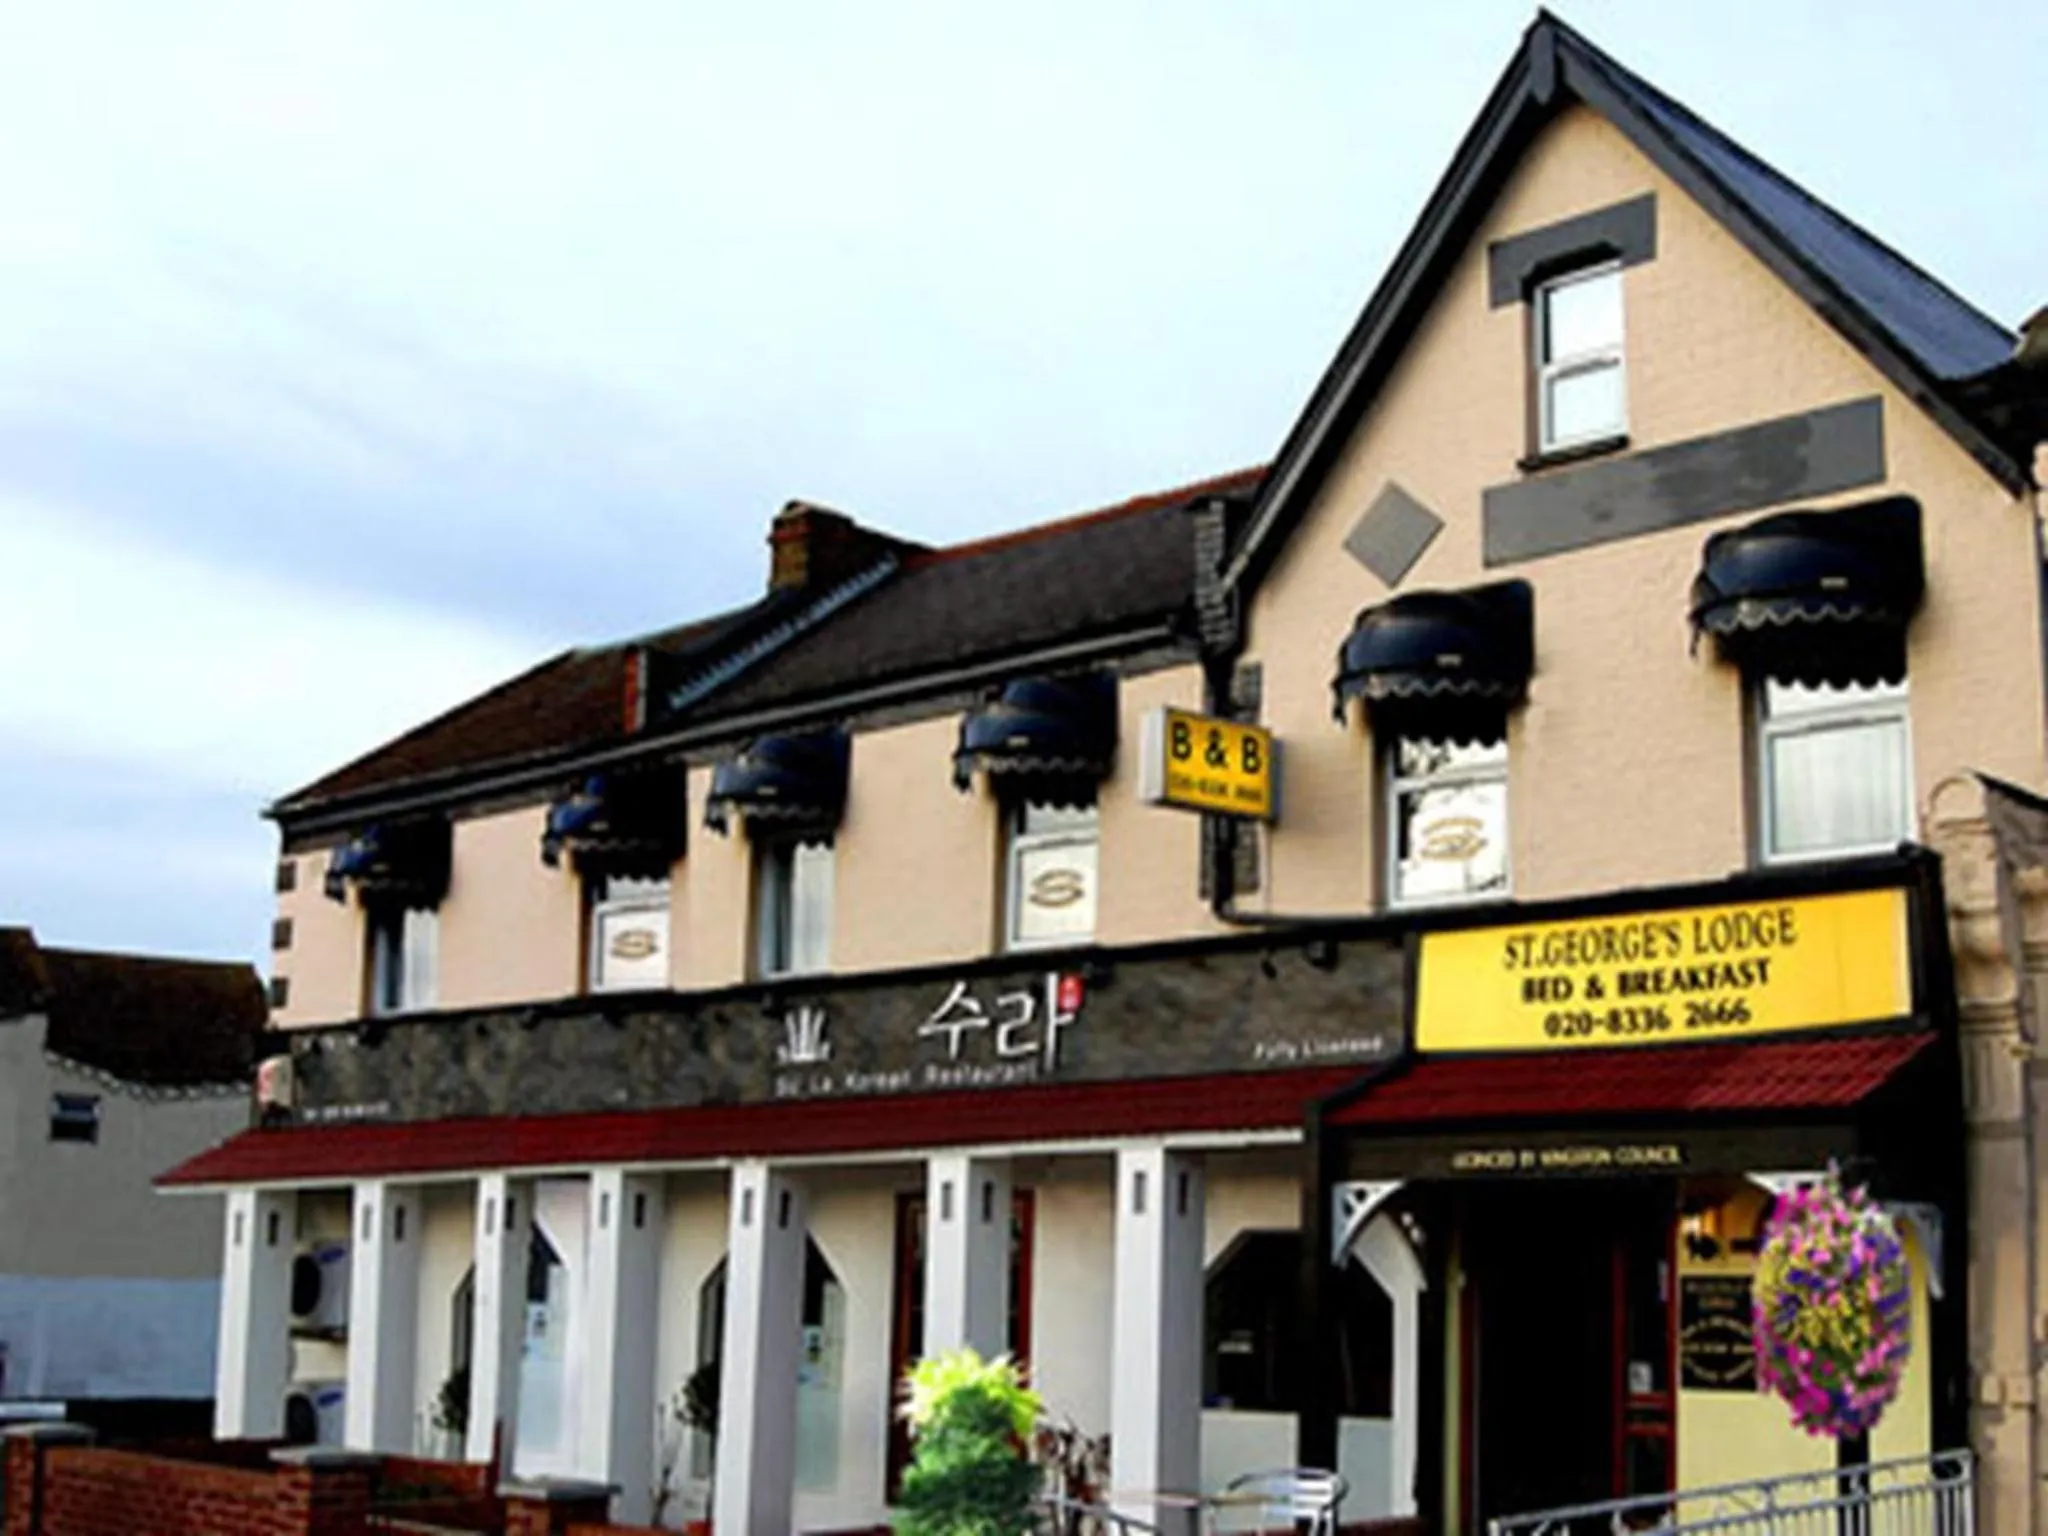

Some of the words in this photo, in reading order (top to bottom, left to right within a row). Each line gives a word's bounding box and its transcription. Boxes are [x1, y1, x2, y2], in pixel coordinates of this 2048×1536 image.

[1172, 722, 1191, 761] B
[1205, 729, 1228, 768] &
[1243, 736, 1261, 773] B
[1693, 907, 1798, 955] LODGE
[1523, 976, 1574, 1002] BED
[1585, 974, 1605, 999] &
[1618, 957, 1772, 997] BREAKFAST
[917, 970, 1076, 1071] 수라
[1544, 1004, 1671, 1037] 020-8336
[1685, 998, 1752, 1029] 2666
[1253, 1040, 1298, 1061] Fully
